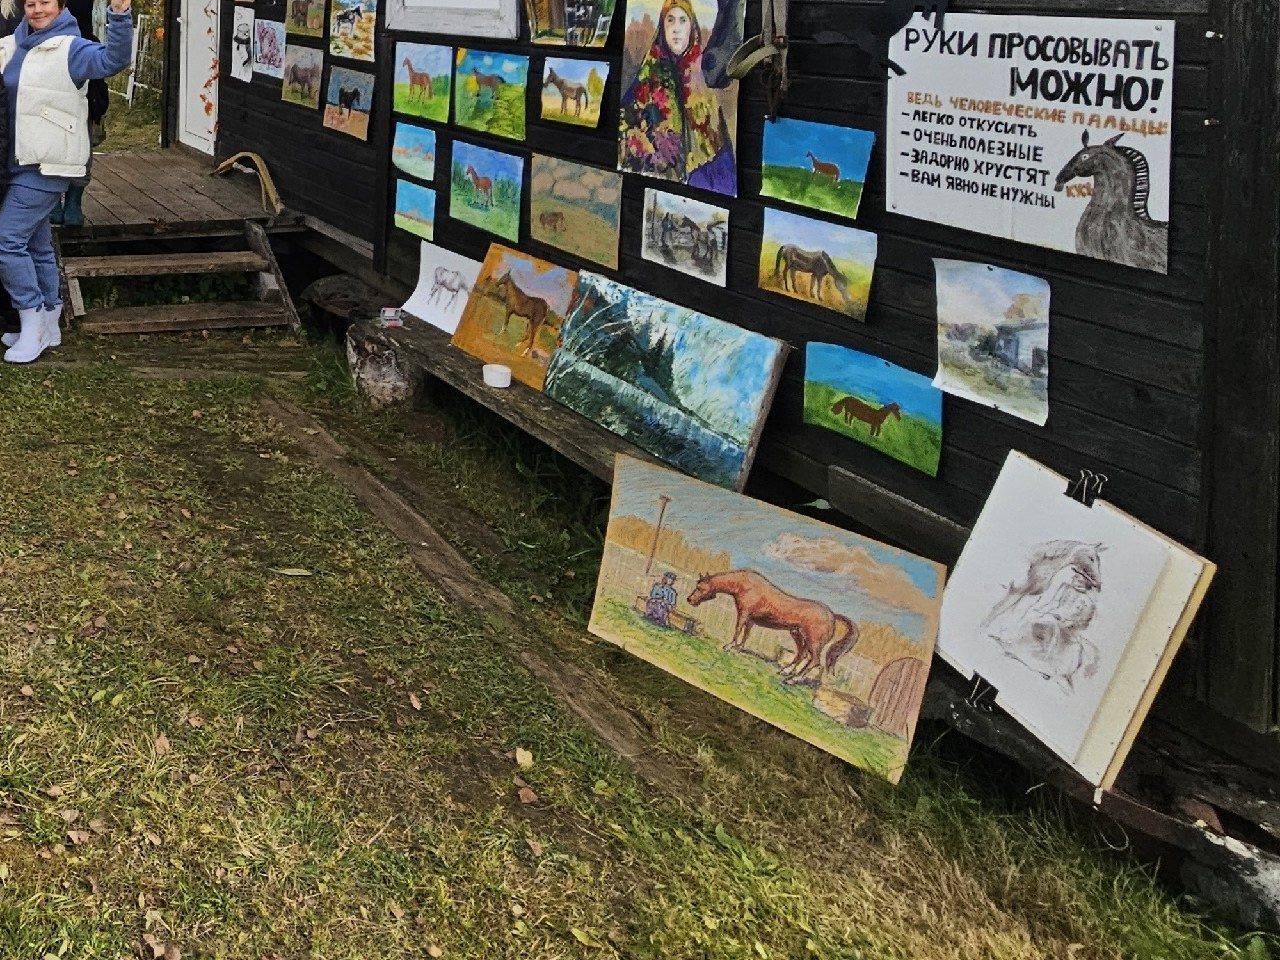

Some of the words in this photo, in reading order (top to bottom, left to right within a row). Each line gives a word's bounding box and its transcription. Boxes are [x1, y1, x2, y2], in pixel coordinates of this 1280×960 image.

[904, 27, 978, 57] РУКИ
[987, 32, 1170, 71] ПРОСОВЫВАТЬ
[907, 91, 943, 109] ВЕДЬ
[949, 97, 1066, 124] ЧЕЛОВЕЧЕСКИЕ
[1009, 66, 1164, 114] МОЖНО!
[912, 109, 955, 126] ЛЕГКО
[958, 115, 1038, 138] ОТКУСИТЬ
[913, 128, 957, 148] ОЧЕНЬ
[958, 135, 1044, 162] ПОЛЕЗНЫЕ
[910, 148, 969, 172] ЗАДОРНО
[973, 158, 1050, 187] ХРУСТЯТ
[911, 169, 941, 188] ВАМ
[946, 175, 979, 194] ЯВНО
[981, 184, 998, 198] НЕ
[1000, 186, 1056, 209] НУЖНЫ
